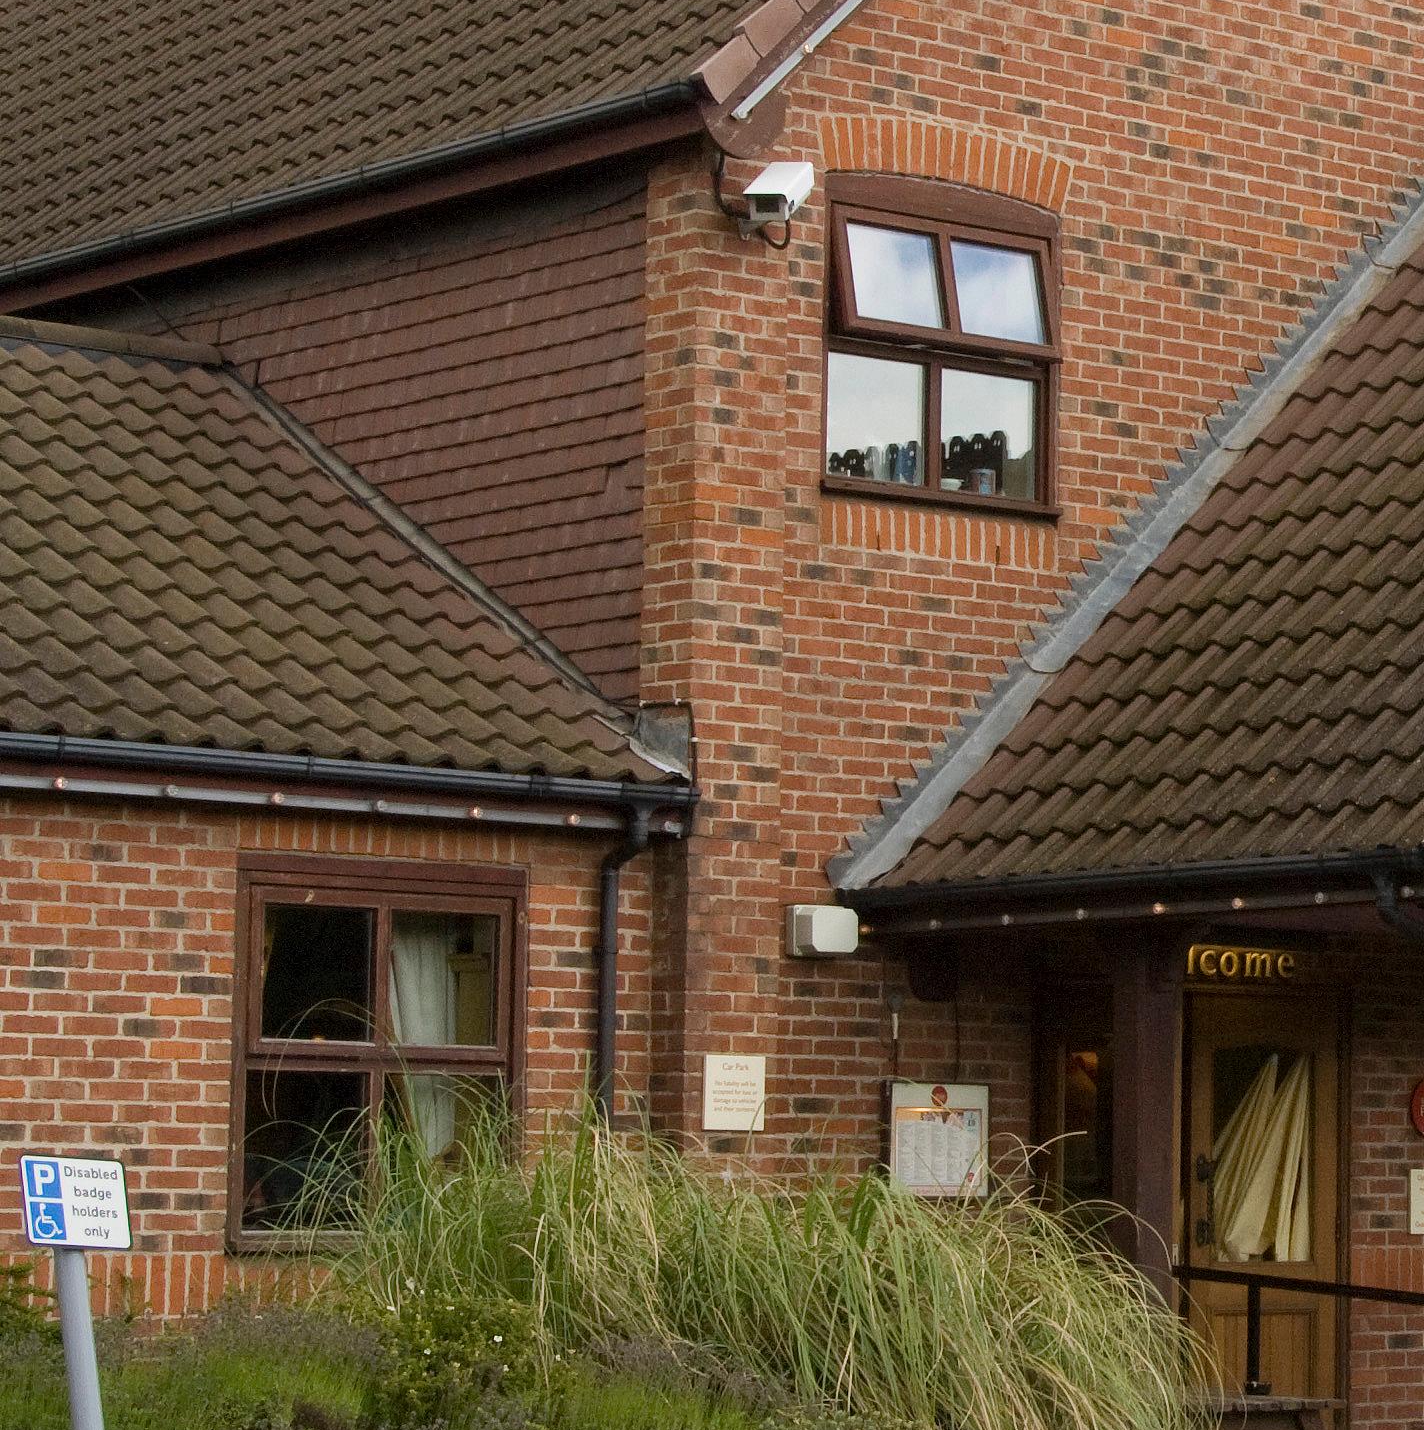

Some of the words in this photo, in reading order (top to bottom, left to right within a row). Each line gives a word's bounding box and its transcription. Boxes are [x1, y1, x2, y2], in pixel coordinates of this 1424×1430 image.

[64, 1166, 118, 1180] Disabled
[74, 1186, 112, 1200] badge
[72, 1206, 118, 1218] holders
[84, 1226, 110, 1239] only
